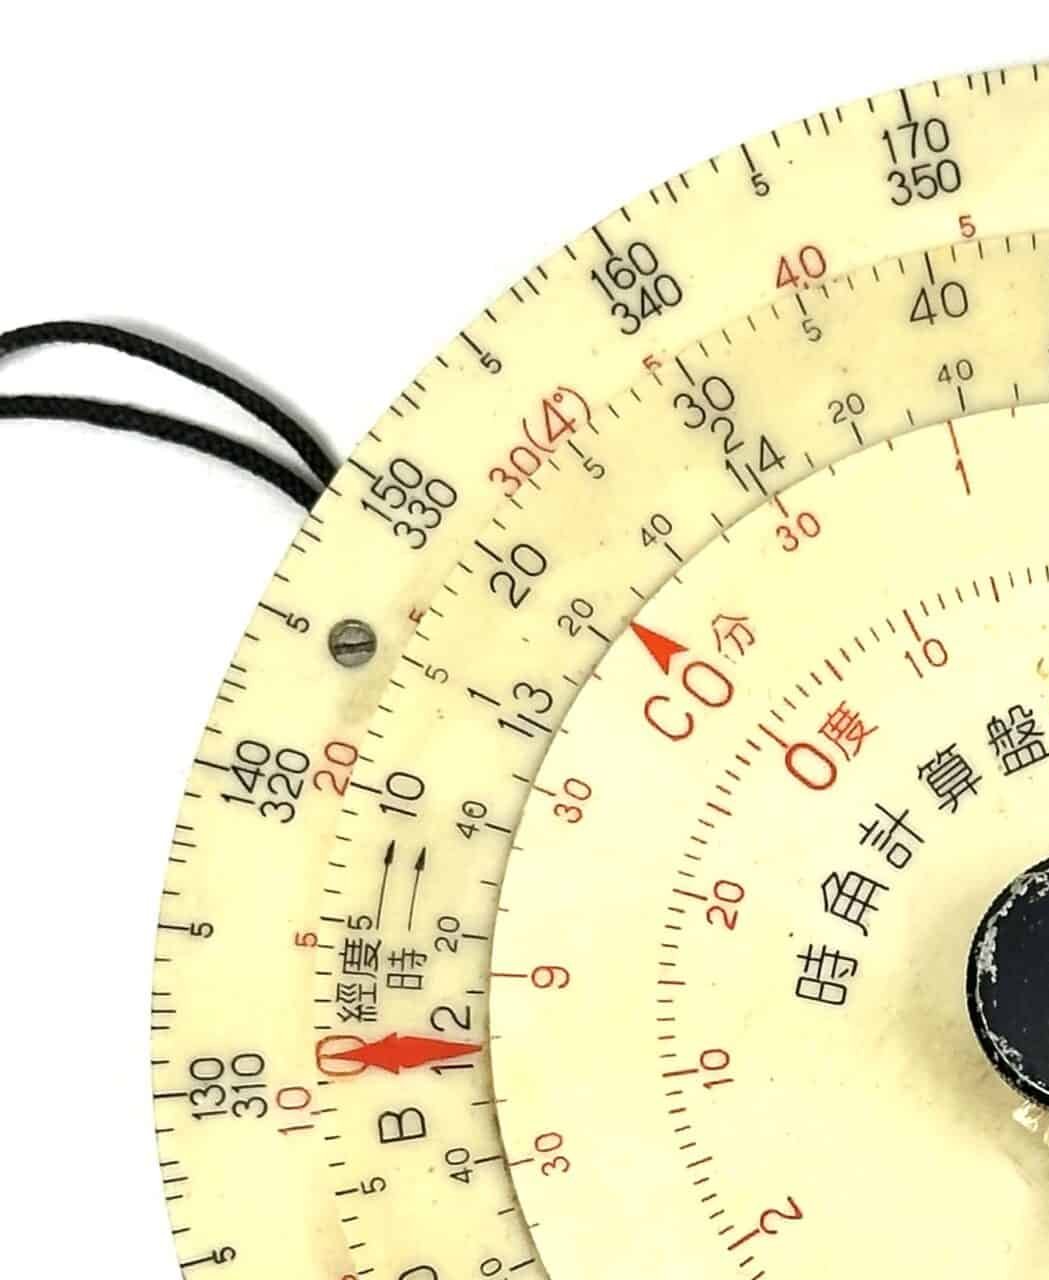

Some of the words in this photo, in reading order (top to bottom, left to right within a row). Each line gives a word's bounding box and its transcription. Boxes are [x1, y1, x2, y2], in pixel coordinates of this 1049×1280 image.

[882, 118, 950, 163] 170
[888, 160, 961, 206] 350
[592, 242, 658, 301] 160
[776, 246, 827, 289] 40
[611, 274, 683, 335] 340
[909, 282, 968, 325] 40
[674, 376, 735, 429] 30
[828, 393, 864, 423] 20
[361, 458, 423, 522] 150
[393, 478, 458, 550] 330
[490, 544, 547, 607] 20
[286, 616, 310, 633] 5
[712, 614, 755, 665] 分
[425, 665, 448, 683] 5
[904, 639, 947, 678] 10
[313, 741, 358, 796] 20
[784, 741, 838, 790] 0
[817, 701, 879, 761] 度
[221, 740, 271, 804] 140
[260, 748, 310, 823] 320
[379, 772, 424, 817] 10
[457, 801, 487, 838] 40
[554, 777, 592, 823] 30
[707, 880, 744, 930] 20
[531, 966, 570, 988] 9
[190, 1057, 227, 1120] 130
[232, 1053, 268, 1119] 310
[700, 1049, 734, 1089] 10
[277, 1087, 314, 1135] 10
[379, 1107, 426, 1144] B
[760, 1196, 802, 1234] 2
